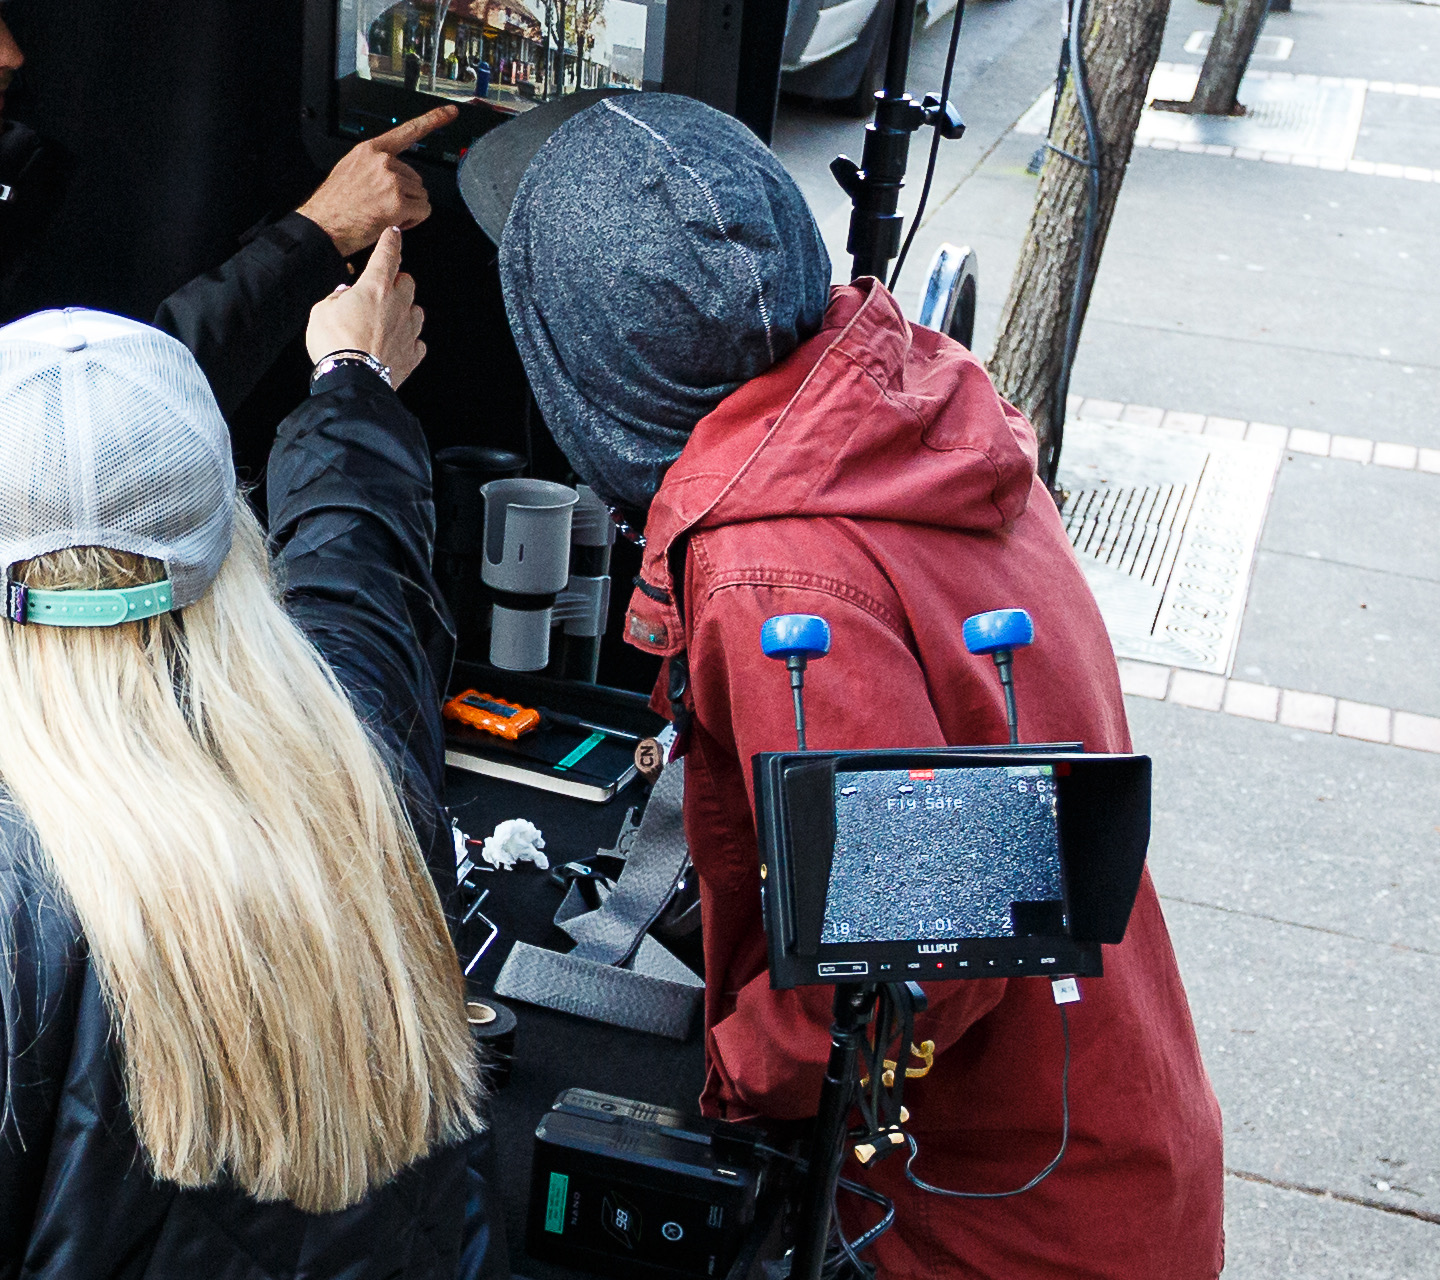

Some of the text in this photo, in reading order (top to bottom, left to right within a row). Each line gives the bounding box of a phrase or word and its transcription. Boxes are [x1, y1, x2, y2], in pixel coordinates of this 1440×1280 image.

[887, 797, 964, 811] Fly Safe
[917, 943, 960, 954] LILLIPUT
